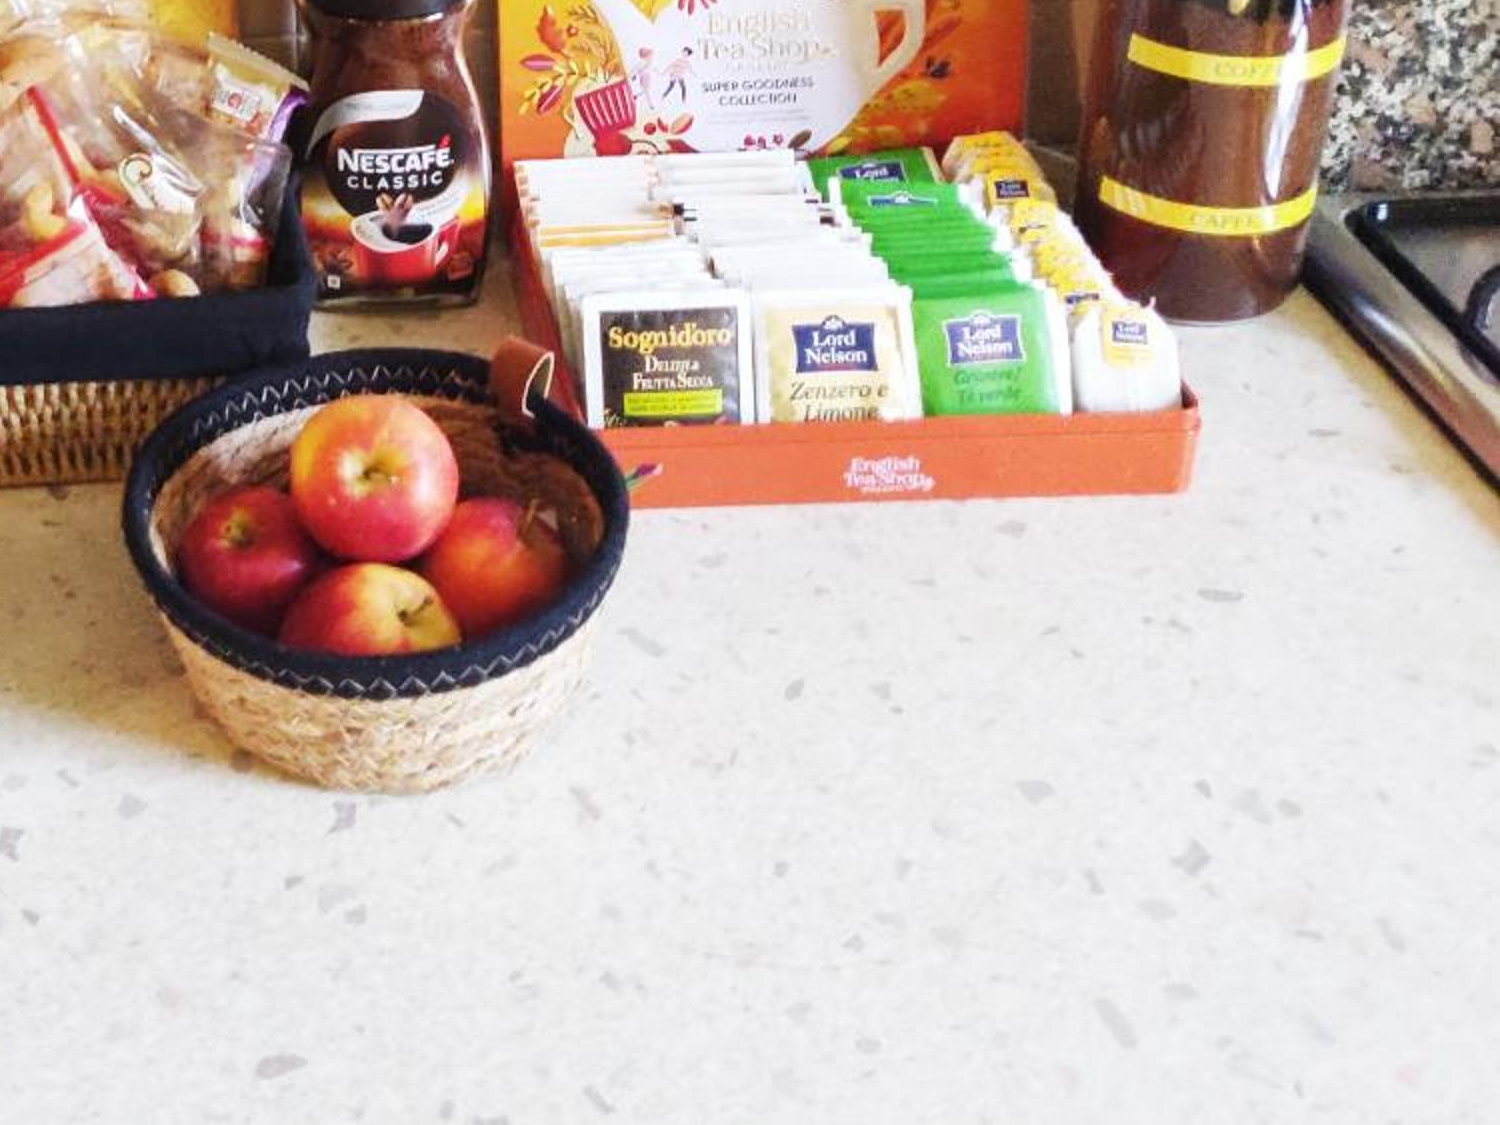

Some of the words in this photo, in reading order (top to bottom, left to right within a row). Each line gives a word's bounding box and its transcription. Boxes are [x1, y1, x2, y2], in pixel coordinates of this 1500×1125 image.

[708, 10, 812, 38] English
[698, 38, 746, 60] Tea
[751, 35, 820, 63] Shop
[702, 79, 739, 93] SUPER
[741, 75, 815, 91] GOODNESS
[719, 92, 797, 107] COLLECTION
[337, 133, 452, 174] NESCAFÉ
[347, 170, 443, 190] CLASSIC
[812, 329, 857, 347] Lord
[962, 324, 1001, 341] Lord
[804, 347, 869, 364] Nelson
[957, 342, 1013, 358] Nelson
[790, 381, 873, 401] Zenzero
[877, 383, 889, 398] e
[804, 404, 880, 422] Limone
[847, 455, 920, 474] English
[843, 472, 876, 487] Tea
